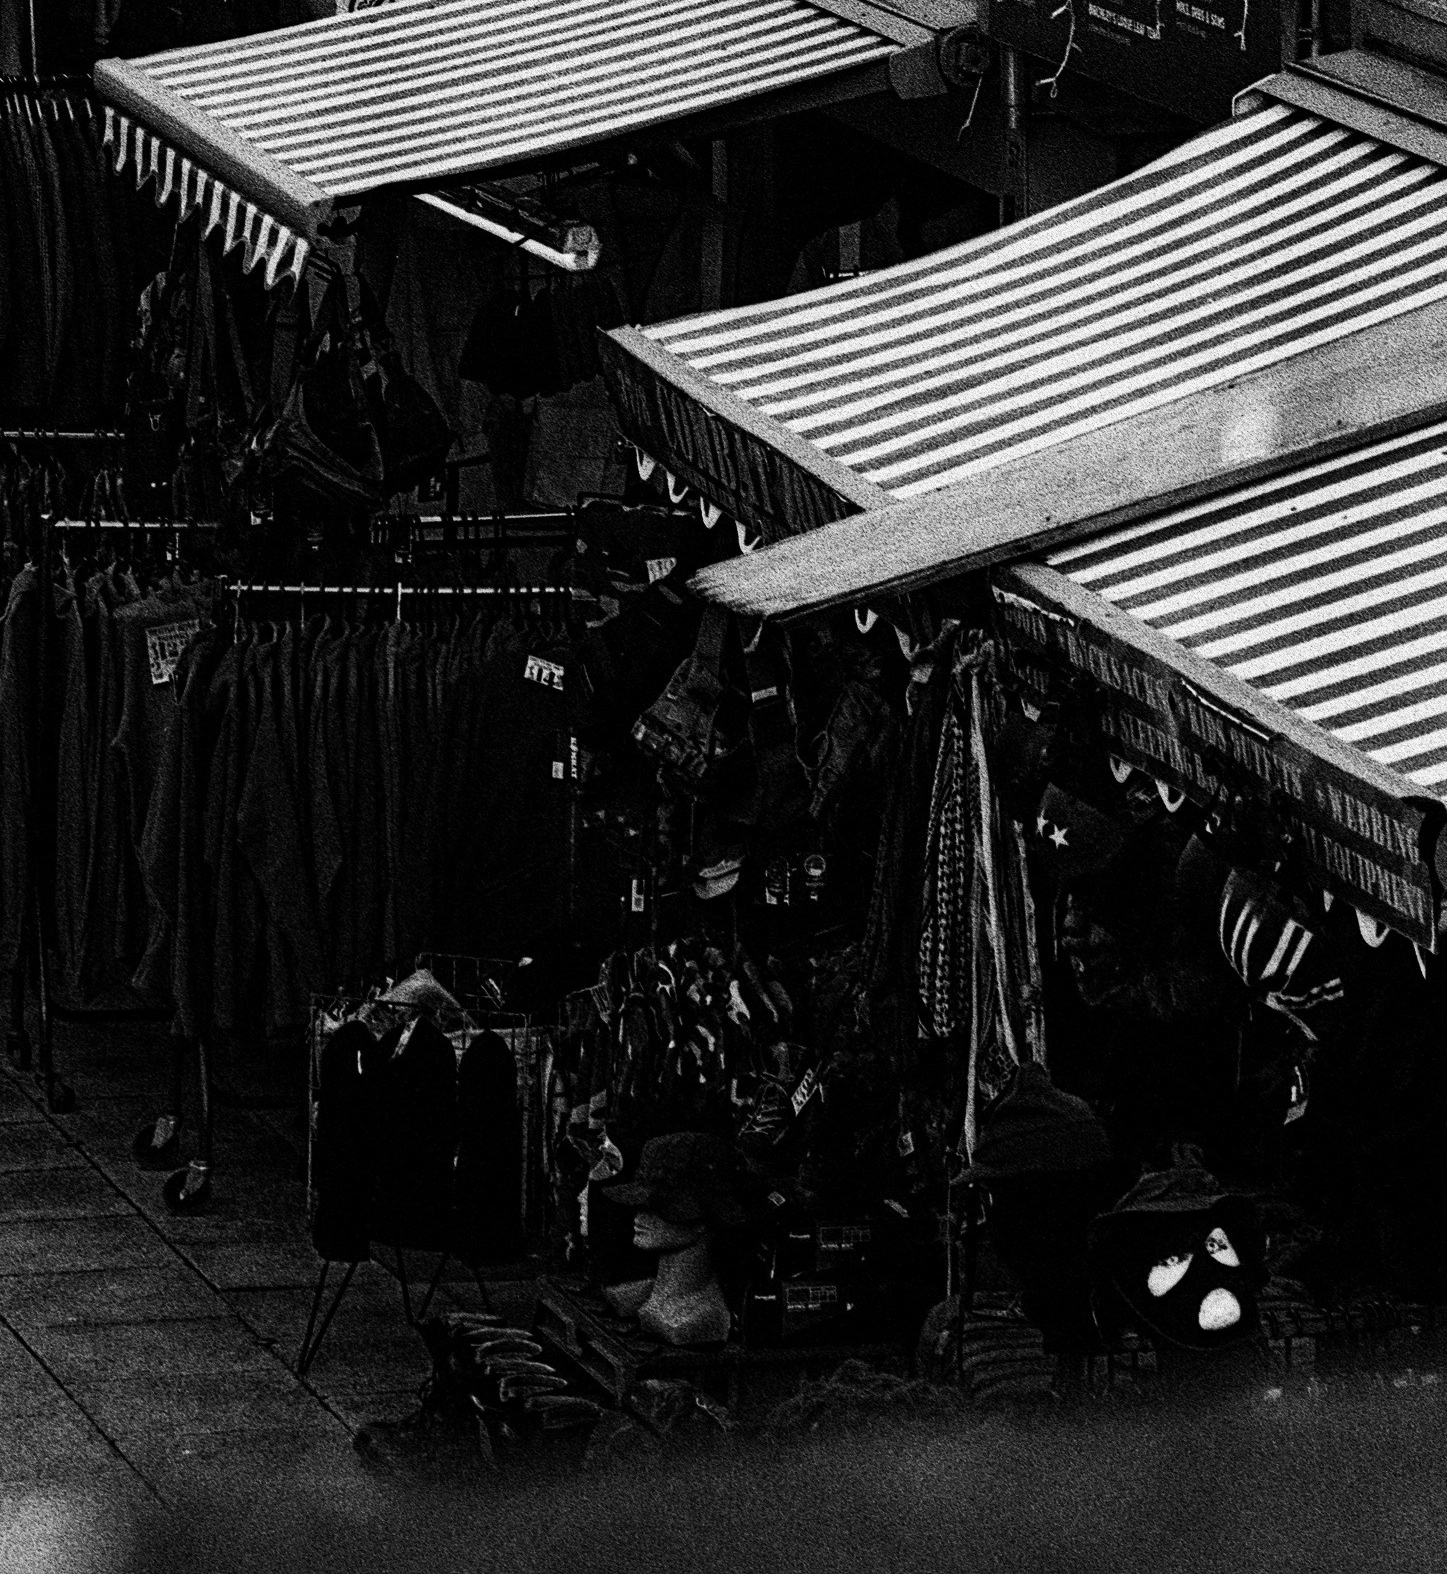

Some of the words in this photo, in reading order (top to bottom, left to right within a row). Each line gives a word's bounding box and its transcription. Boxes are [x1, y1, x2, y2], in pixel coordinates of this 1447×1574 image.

[1116, 711, 1195, 780] SLEEPING
[1325, 783, 1421, 868] WEBBING
[1321, 834, 1427, 926] EQUIPMENT
